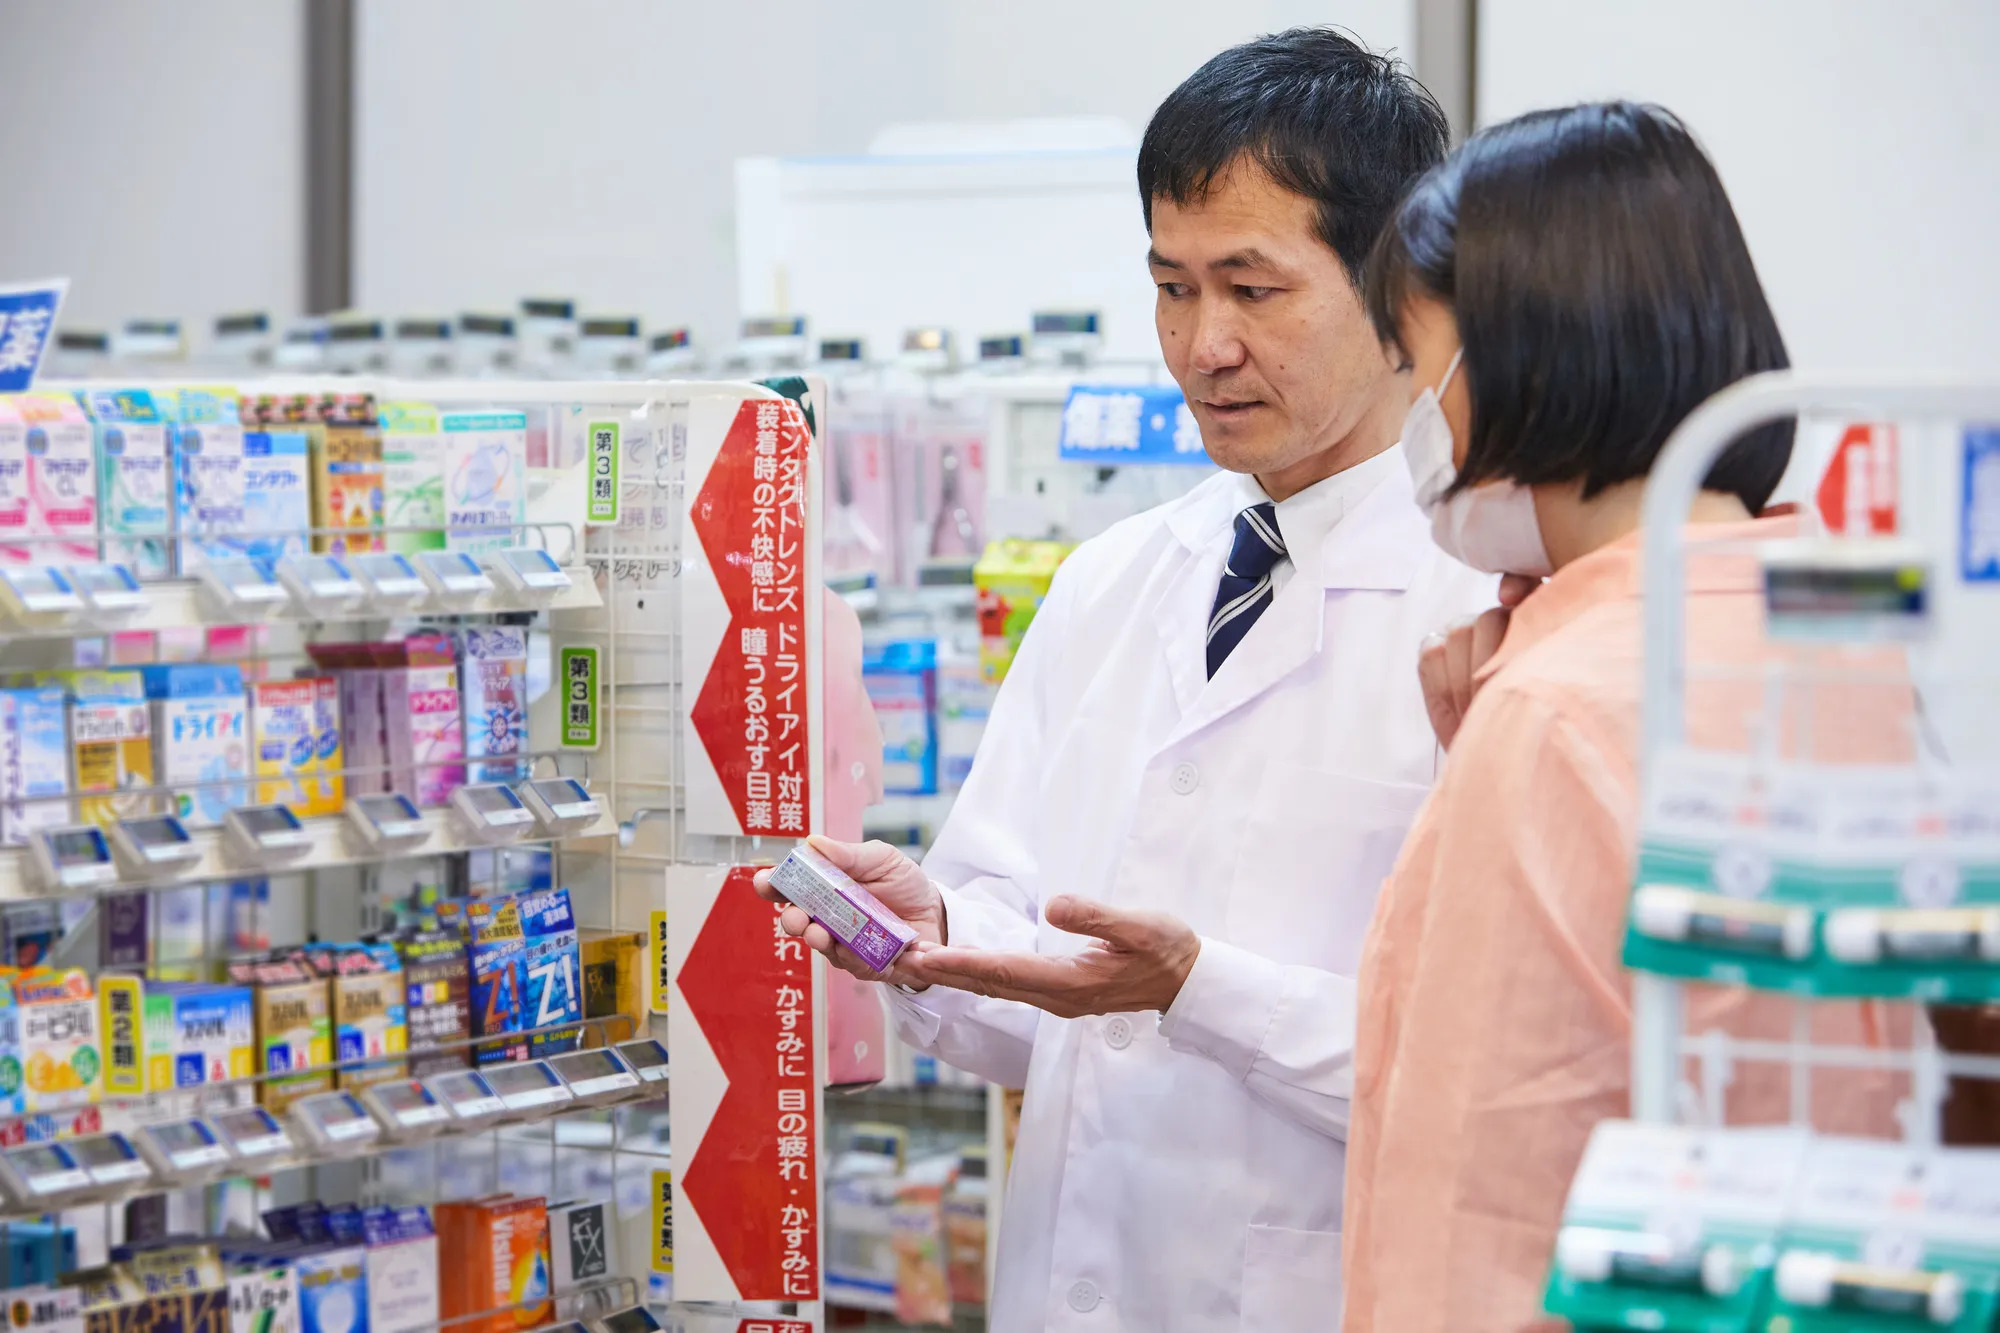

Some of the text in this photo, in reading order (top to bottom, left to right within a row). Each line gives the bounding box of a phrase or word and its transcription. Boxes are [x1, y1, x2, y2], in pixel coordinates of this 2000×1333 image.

[595, 431, 611, 499] 第3類
[568, 656, 590, 726] 第3類
[741, 403, 779, 829] 装着時の不快感に 瞳うるおす目薬
[775, 402, 804, 831] コンタクトレンズ ドライアイ対策
[528, 952, 577, 1027] Z!
[773, 902, 811, 1295] れ・かすみに 目の疲れ・かすみに
